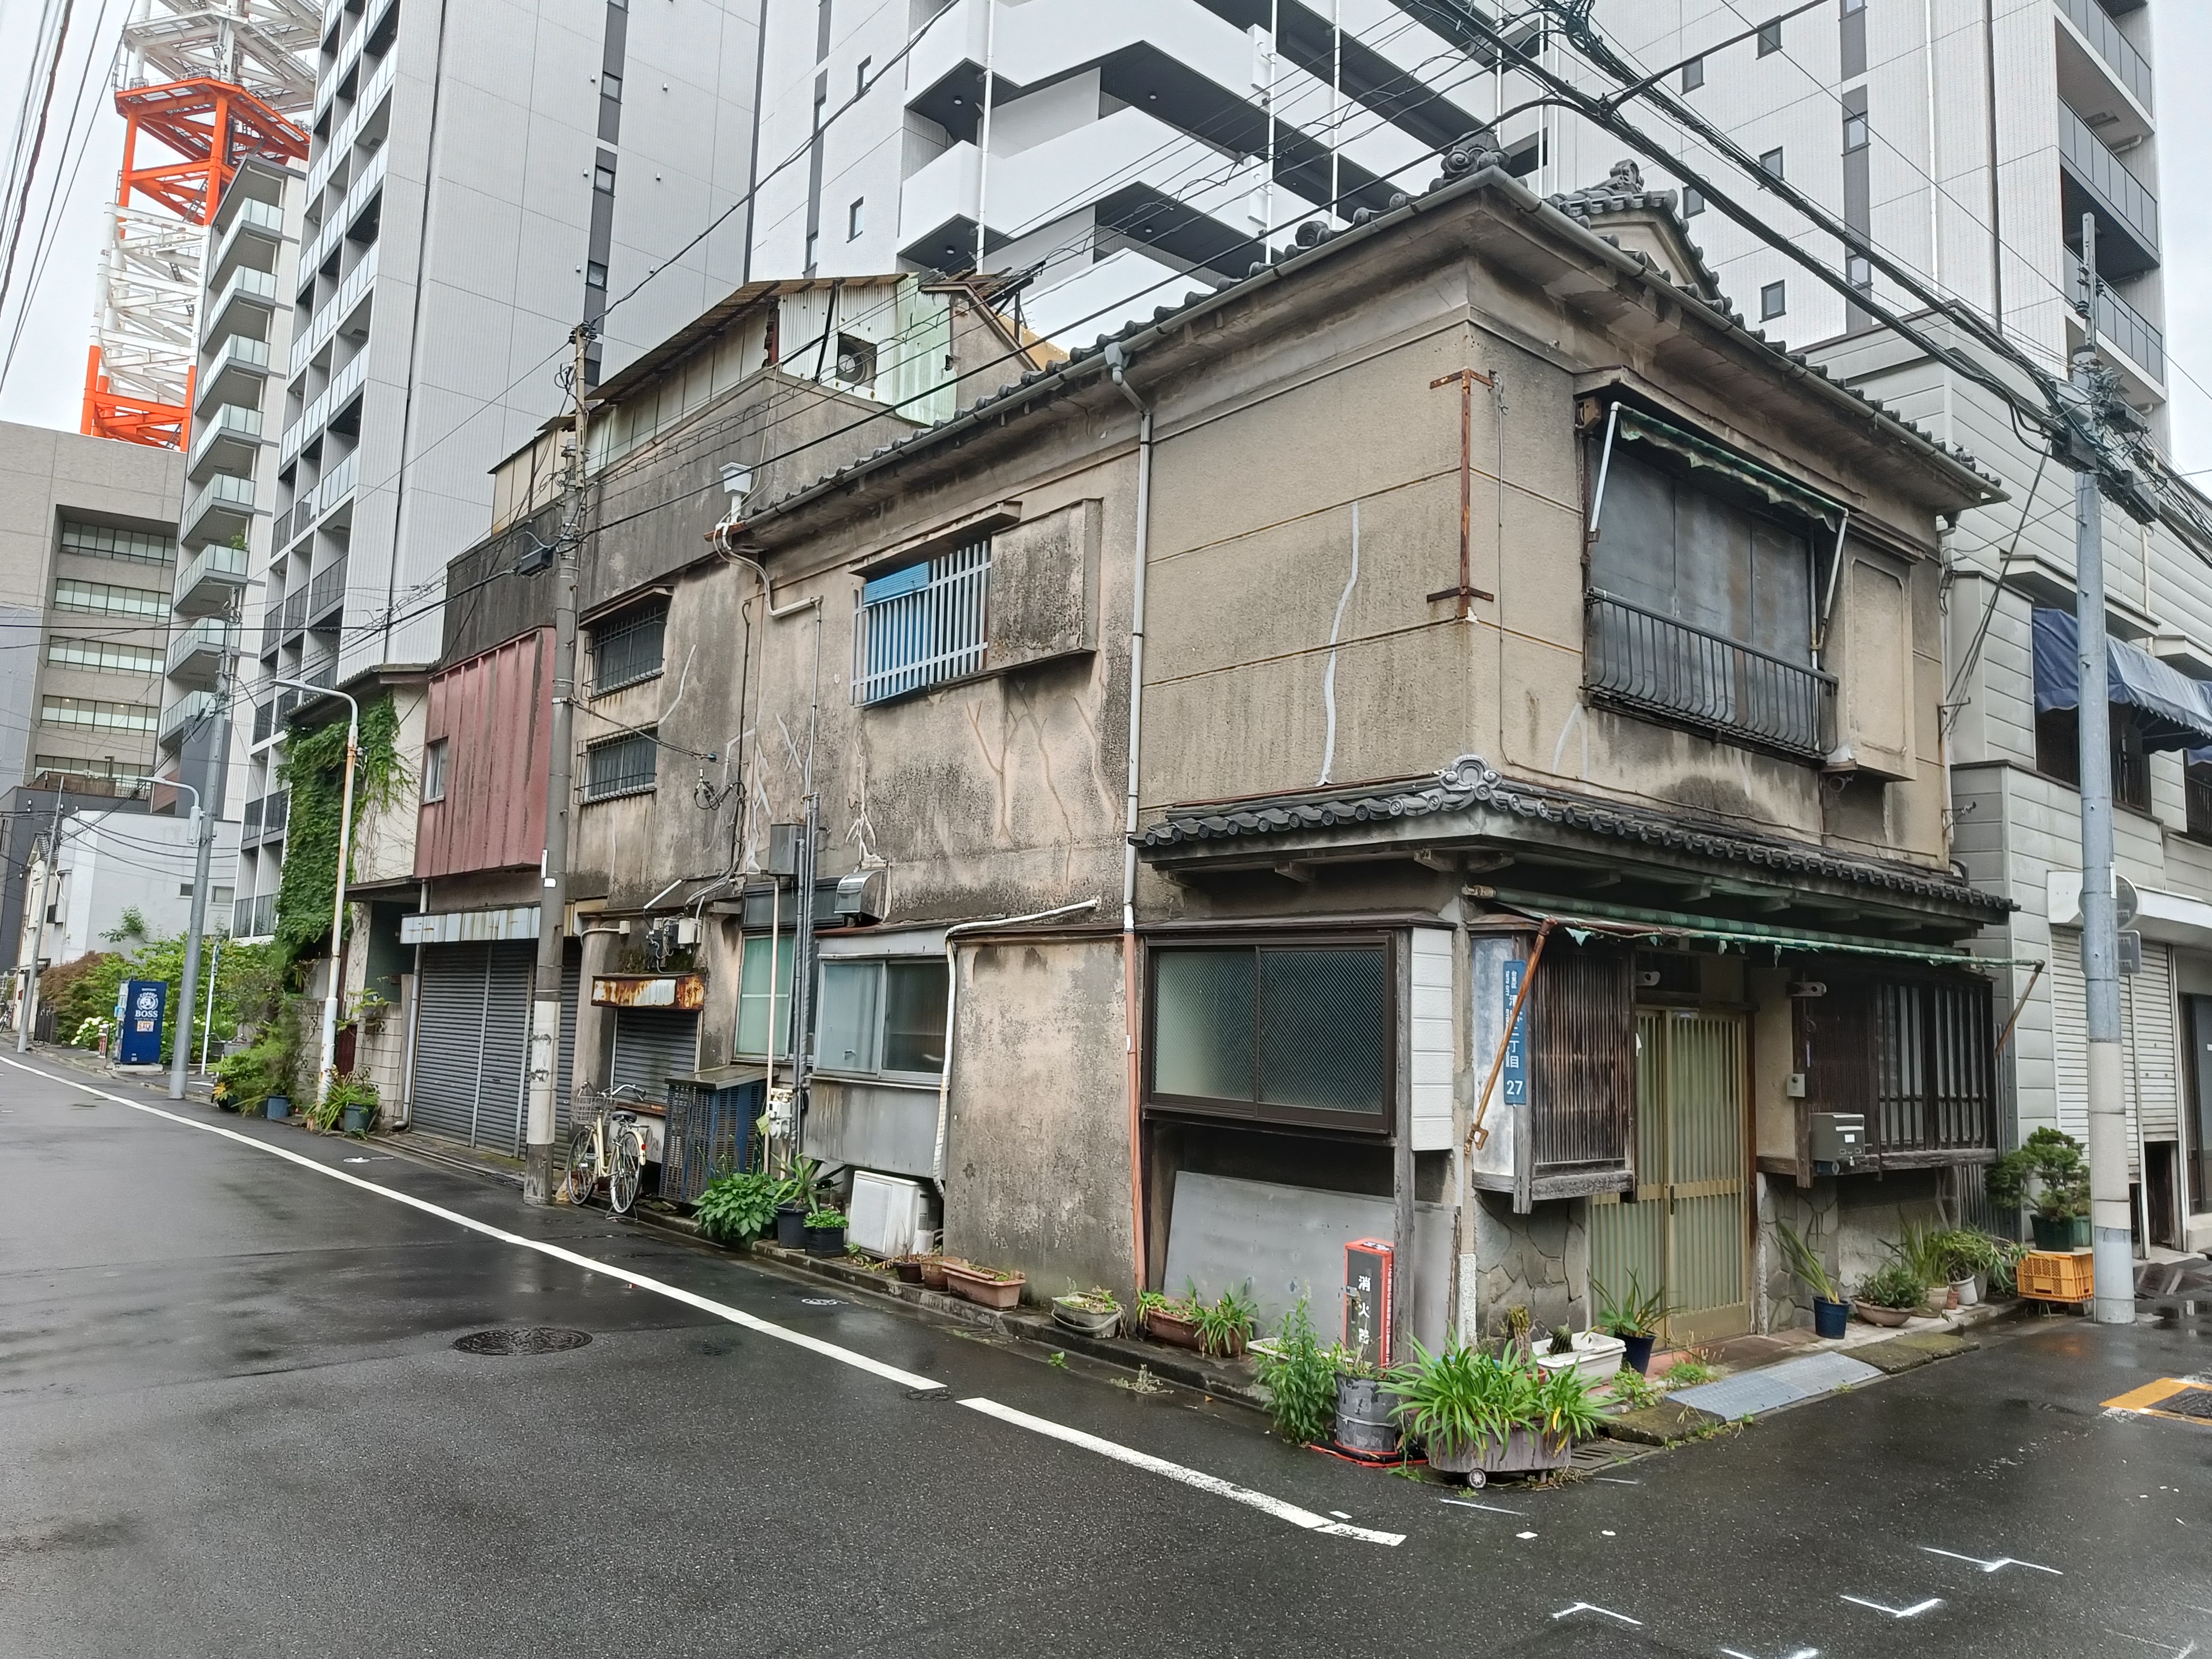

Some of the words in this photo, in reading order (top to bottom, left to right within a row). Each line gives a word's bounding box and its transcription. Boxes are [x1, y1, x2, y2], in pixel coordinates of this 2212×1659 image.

[135, 1010, 158, 1018] BOSS
[1506, 1080, 1523, 1095] 27
[1358, 1275, 1371, 1345] 消火器
